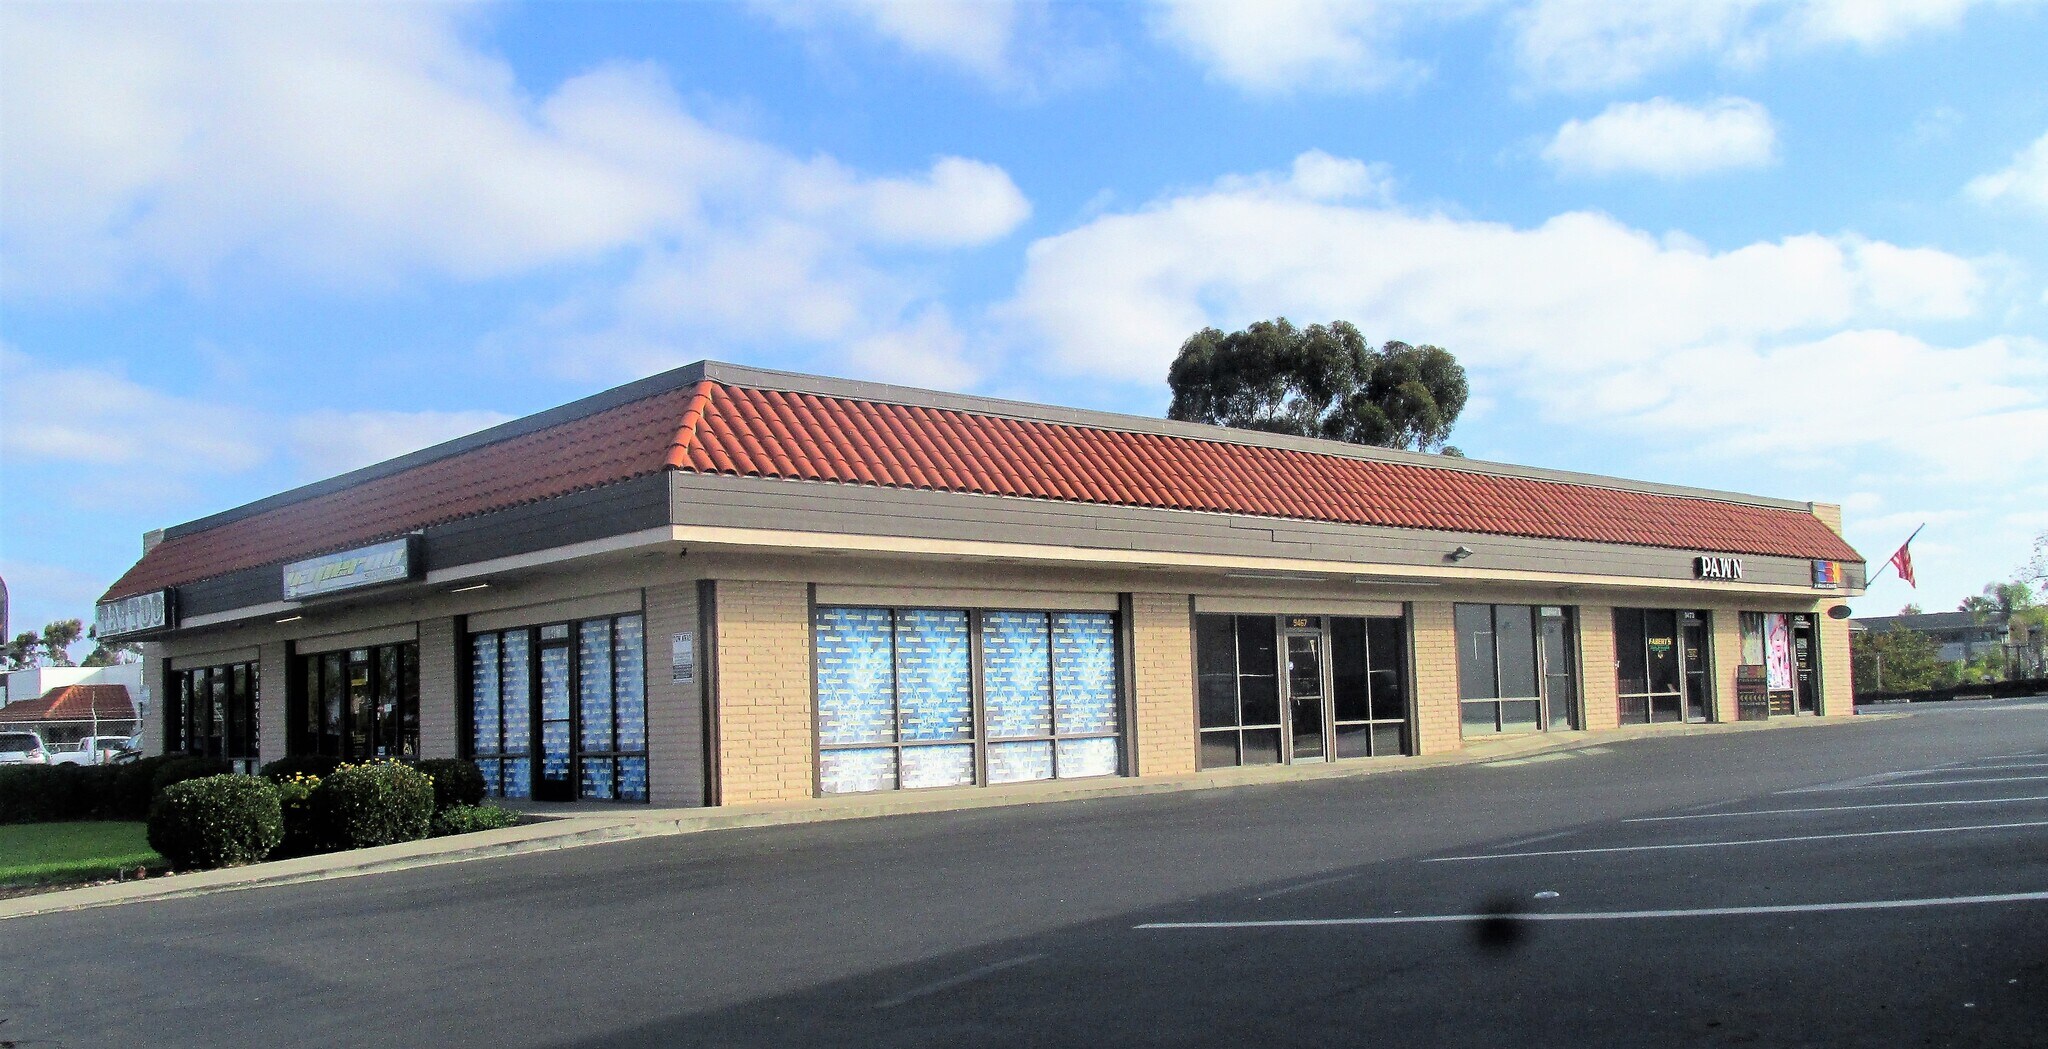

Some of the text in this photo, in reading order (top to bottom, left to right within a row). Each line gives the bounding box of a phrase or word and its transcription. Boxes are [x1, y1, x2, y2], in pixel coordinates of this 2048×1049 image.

[1701, 556, 1742, 579] PAWN
[99, 593, 164, 635] TATTOO
[1292, 618, 1308, 627] 9467
